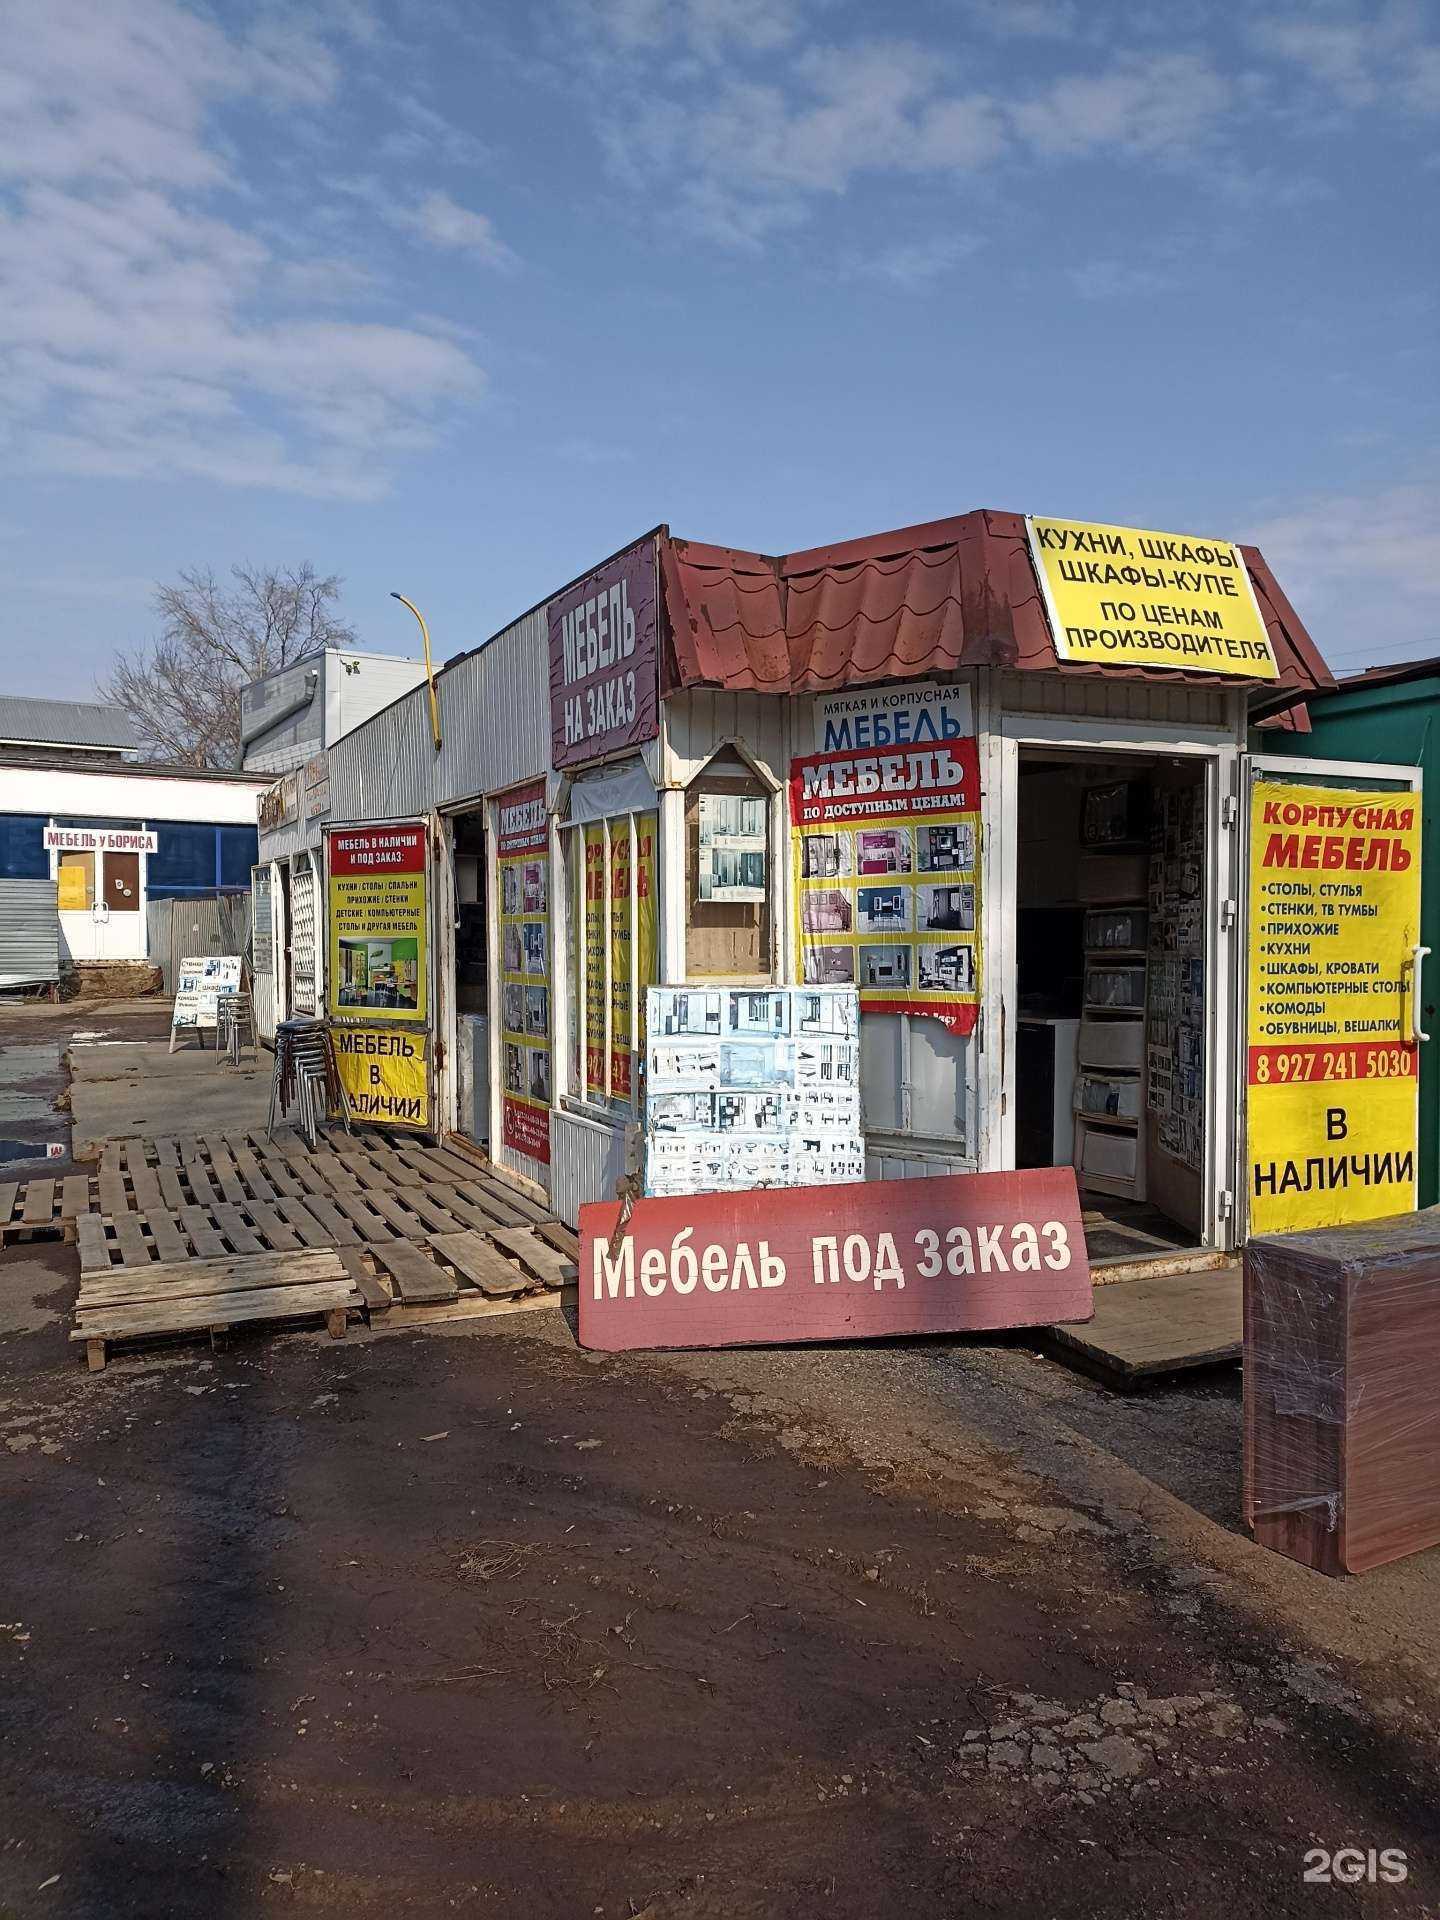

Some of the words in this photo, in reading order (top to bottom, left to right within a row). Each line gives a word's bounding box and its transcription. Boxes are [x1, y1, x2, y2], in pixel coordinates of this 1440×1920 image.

[1036, 527, 1134, 559] КУХНИ,
[1138, 538, 1239, 569] ШКАФЫ
[1058, 559, 1239, 597] ШКАФЫ-КУПЕ
[1100, 601, 1136, 621] ПО
[1142, 604, 1223, 630] ЦЕНАМ
[561, 579, 636, 686] МЕБЕЛЬ
[1066, 627, 1271, 661] ПРОИЗВОДИТЕЛЯ
[564, 695, 584, 746] НА
[586, 671, 636, 736] ЗАКАЗ
[824, 699, 867, 715] МЯГКАЯ
[871, 697, 879, 709] И
[882, 687, 960, 707] КОРПУСНАЯ
[824, 706, 961, 751] МЕБЕЛЬ
[802, 750, 964, 800] МЕБЕЛЬ
[501, 798, 547, 835] МЕБЕЛЬ
[803, 806, 820, 819] ПО
[824, 799, 908, 819] ДОСТУПНЫМ
[911, 793, 966, 812] ЦЕНАМ!
[1263, 802, 1414, 831] КОРПУСНАЯ
[47, 832, 96, 847] МЕБЕЛЬ
[108, 834, 153, 849] БОРИСА
[338, 838, 370, 850] МЕБЕЛЬ
[372, 838, 377, 848] В
[379, 835, 417, 848] НАЛИЧИИ
[1262, 833, 1412, 871] МЕБЕЛЬ
[357, 853, 374, 865] ПОД
[376, 852, 405, 863] ЗАКАЗ:
[1268, 883, 1315, 897] СТОЛЫ,
[1319, 884, 1363, 897] СТУЛЬЯ
[1268, 903, 1318, 917] СТЕНКИ,
[1321, 903, 1334, 916] ТВ
[1338, 904, 1378, 916] ТУМБЫ
[1267, 923, 1340, 935] ПРИХОЖИЕ
[1267, 942, 1311, 955] КУХНИ
[1267, 962, 1322, 976] ШКАФЫ,
[1326, 962, 1380, 975] КРОВАТИ
[1266, 981, 1369, 995] КОМПЬЮТЕРНЫЕ
[1372, 981, 1410, 993] СТОЛЫ
[1266, 1001, 1326, 1017] КОМОДЫ
[1266, 1020, 1340, 1035] ОБУВНИЦЫ,
[1344, 1019, 1400, 1033] ВЕШАЛКИ
[340, 1034, 415, 1057] МЕБЕЛЬ
[370, 1065, 380, 1084] В
[1256, 1054, 1270, 1083] 8
[1277, 1053, 1316, 1082] 927
[1323, 1052, 1357, 1080] 241
[1366, 1050, 1411, 1078] 5030
[1327, 1108, 1348, 1141] В
[1254, 1151, 1413, 1196] НАЛИЧИИ
[592, 1226, 786, 1300] Мебель
[812, 1231, 905, 1291] под
[914, 1221, 1072, 1278] заказ
